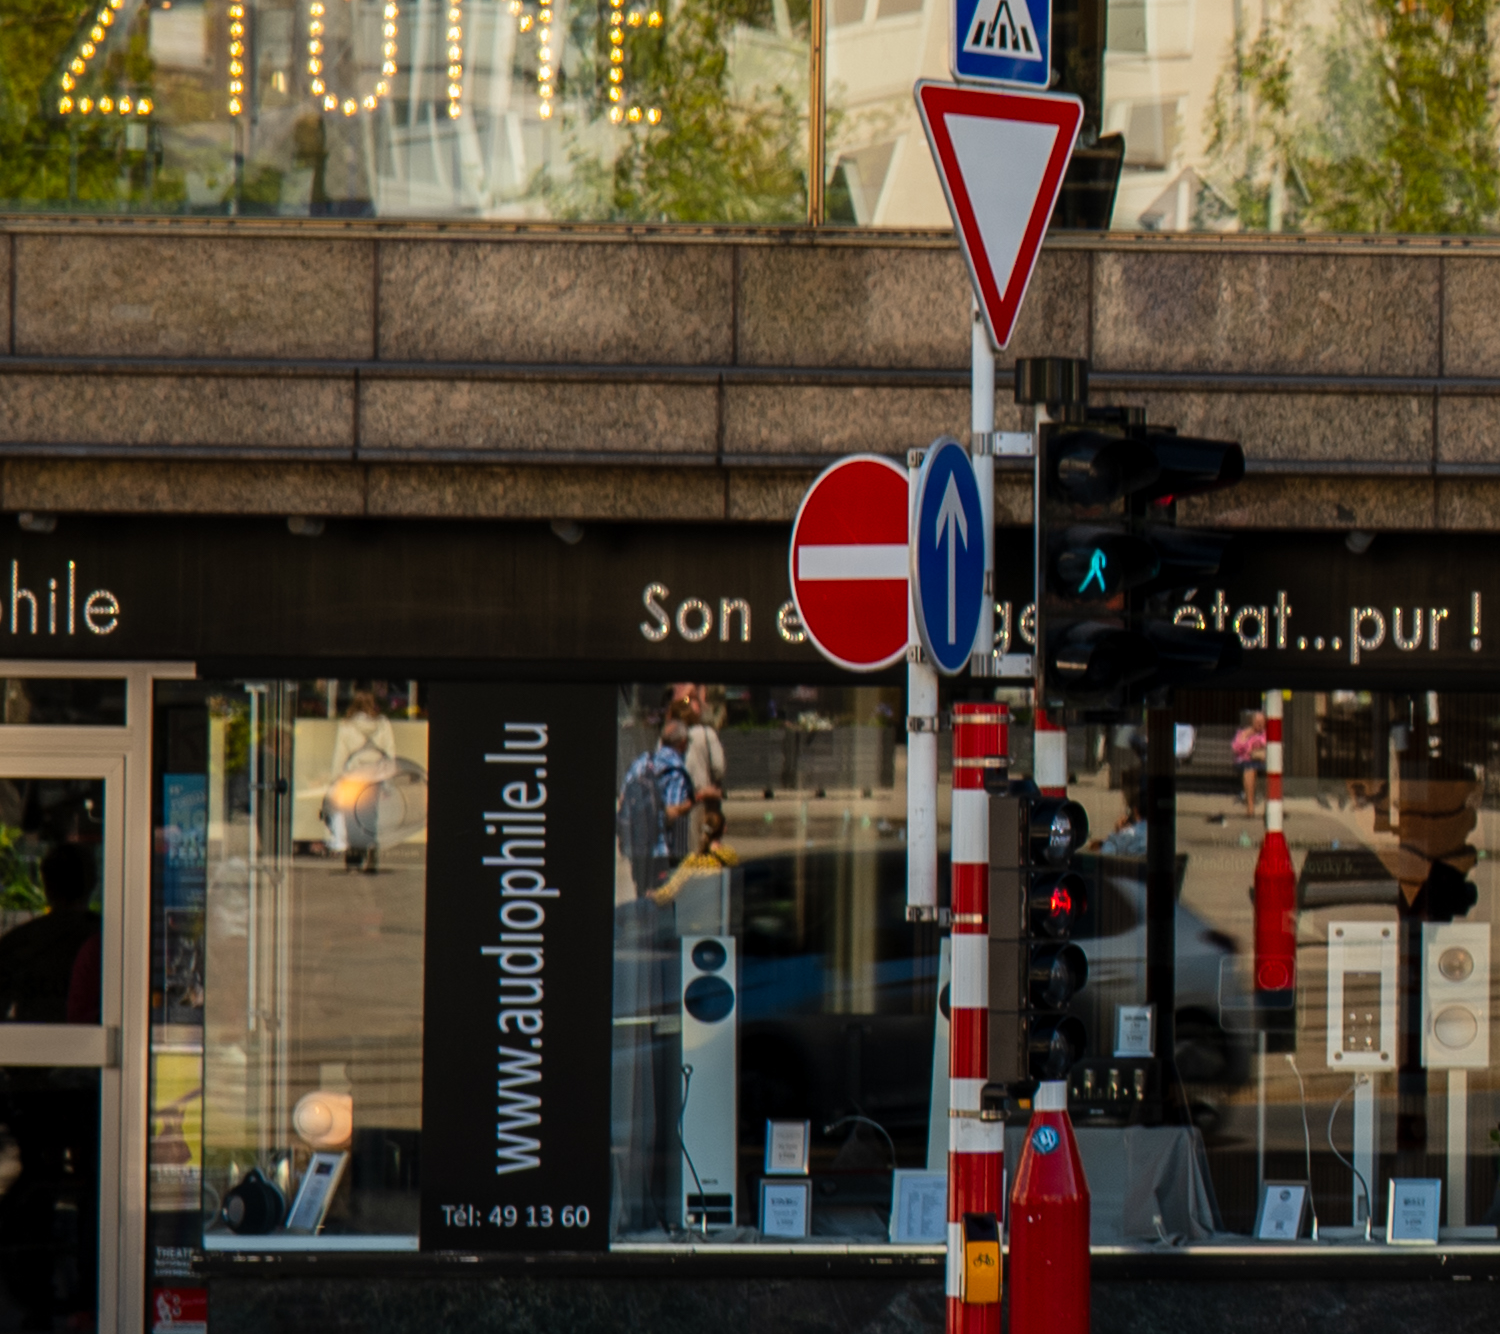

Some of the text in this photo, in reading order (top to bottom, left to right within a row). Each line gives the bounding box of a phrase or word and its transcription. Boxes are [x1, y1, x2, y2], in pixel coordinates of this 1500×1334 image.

[640, 581, 753, 644] Son
[1470, 589, 1483, 652] !
[481, 720, 561, 1177] www.audiophile.lu
[440, 1202, 591, 1229] Tél: 49 13 60
